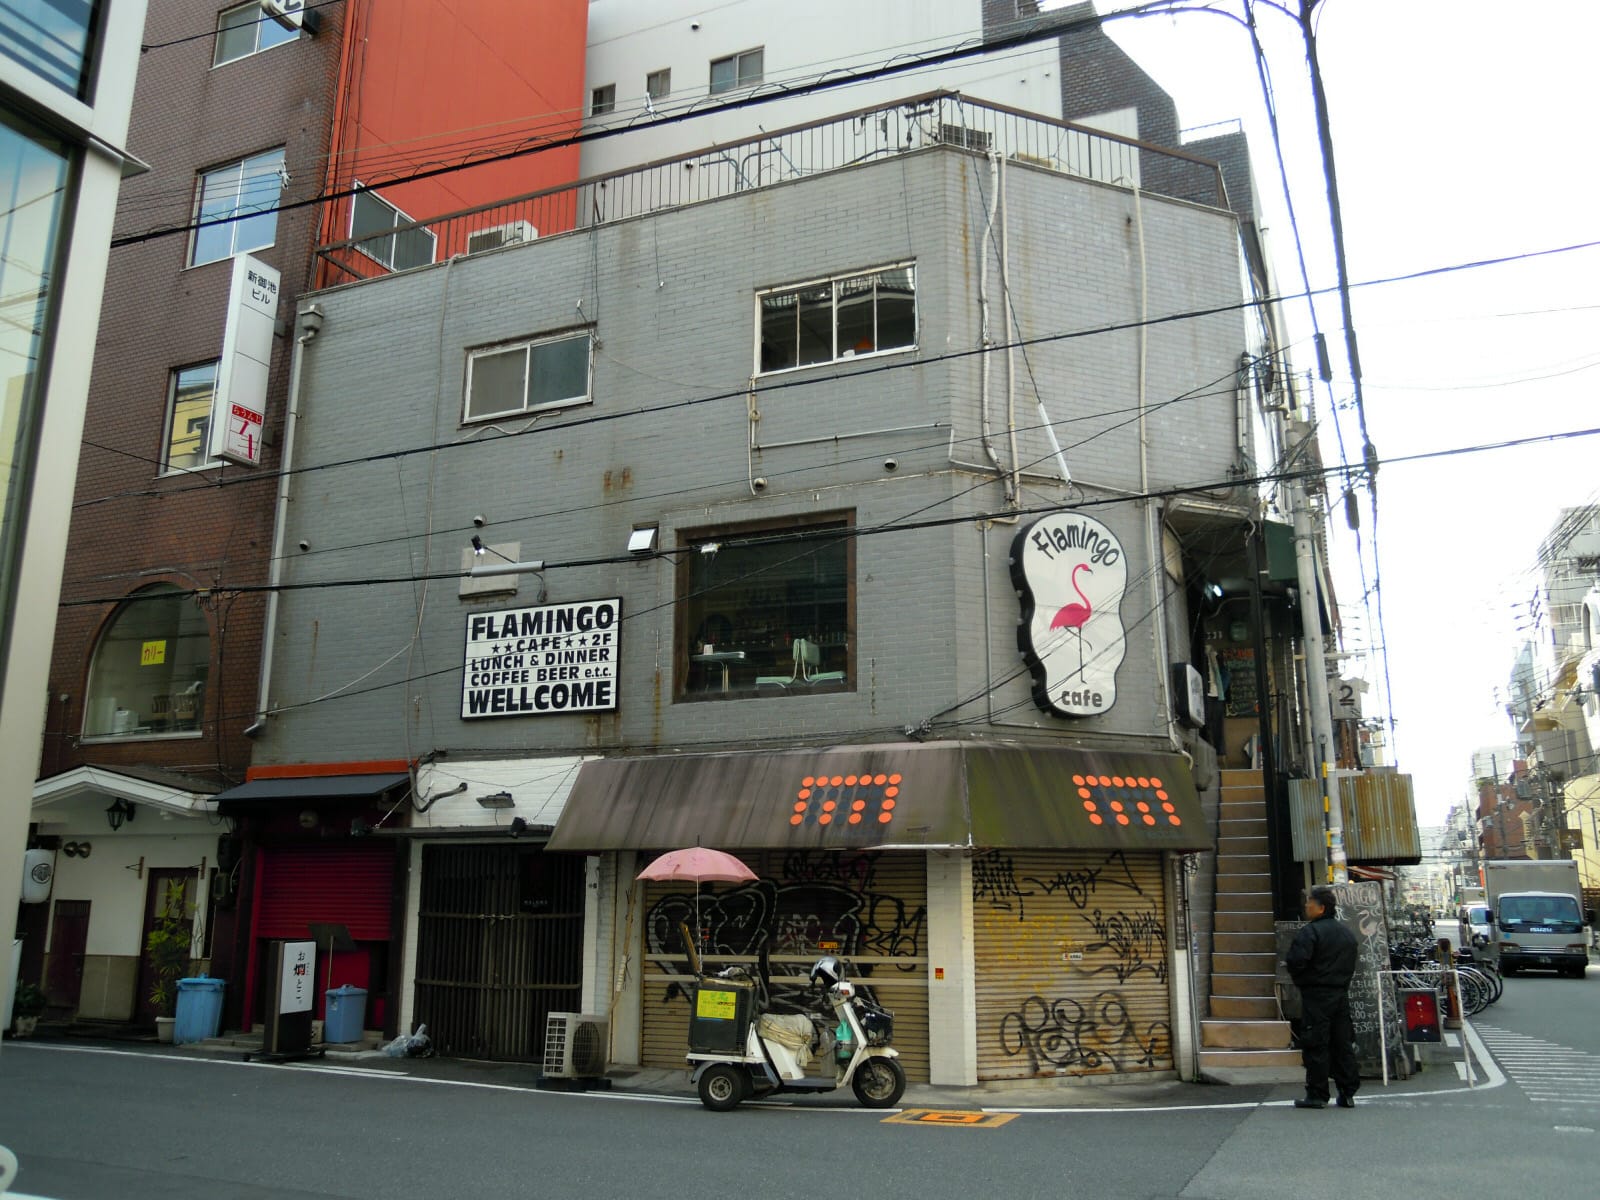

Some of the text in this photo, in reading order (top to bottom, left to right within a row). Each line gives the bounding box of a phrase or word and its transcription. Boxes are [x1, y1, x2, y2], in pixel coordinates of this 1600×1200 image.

[252, 287, 270, 305] ビル
[1032, 521, 1120, 566] Flamingo
[471, 604, 614, 641] FLAMINGO
[516, 633, 612, 653] CAFE 2F
[471, 648, 610, 671] LUNCH & DINNER
[471, 670, 530, 686] COFFEE
[536, 666, 580, 682] BEER
[469, 680, 612, 714] WELLCOME
[1061, 689, 1103, 708] cafe
[1339, 685, 1354, 702] 2
